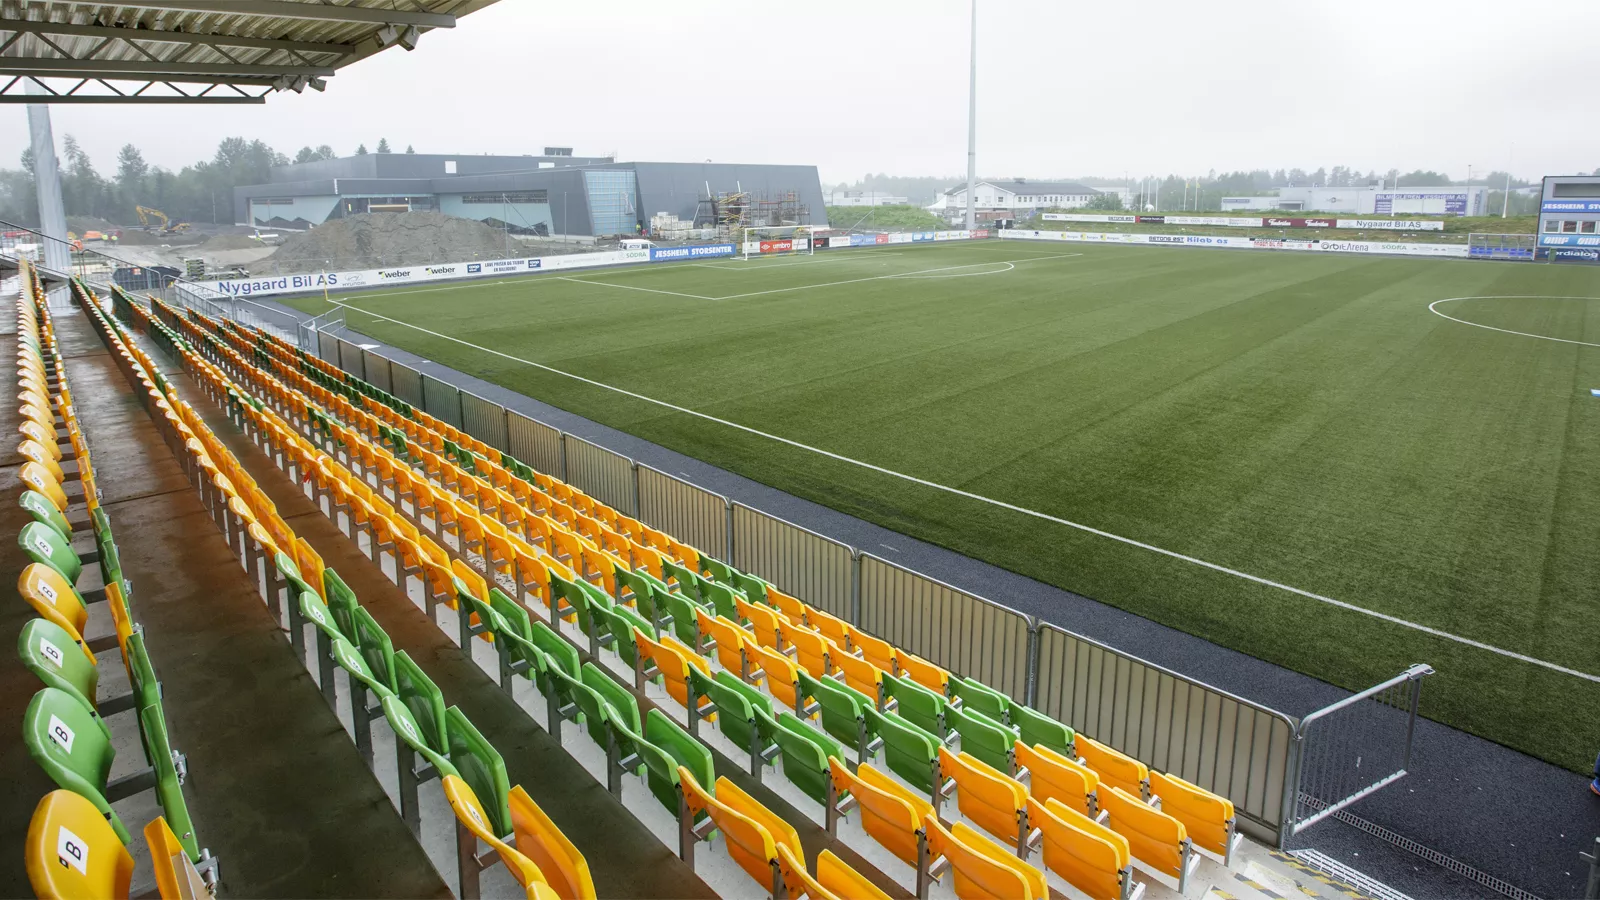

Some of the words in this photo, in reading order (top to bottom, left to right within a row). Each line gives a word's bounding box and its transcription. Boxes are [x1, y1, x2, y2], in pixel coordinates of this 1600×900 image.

[1356, 220, 1393, 229] Nygaard
[1394, 220, 1406, 228] Bil
[655, 249, 689, 258] JESSHEIM
[691, 246, 732, 255] STORSENTER
[1545, 250, 1599, 258] nrdialog
[384, 270, 411, 278] weber
[431, 266, 455, 275] weber
[218, 277, 287, 295] Nygaard
[293, 276, 312, 288] Bil
[317, 273, 338, 286] AS
[55, 725, 68, 743] B
[65, 840, 82, 861] B
